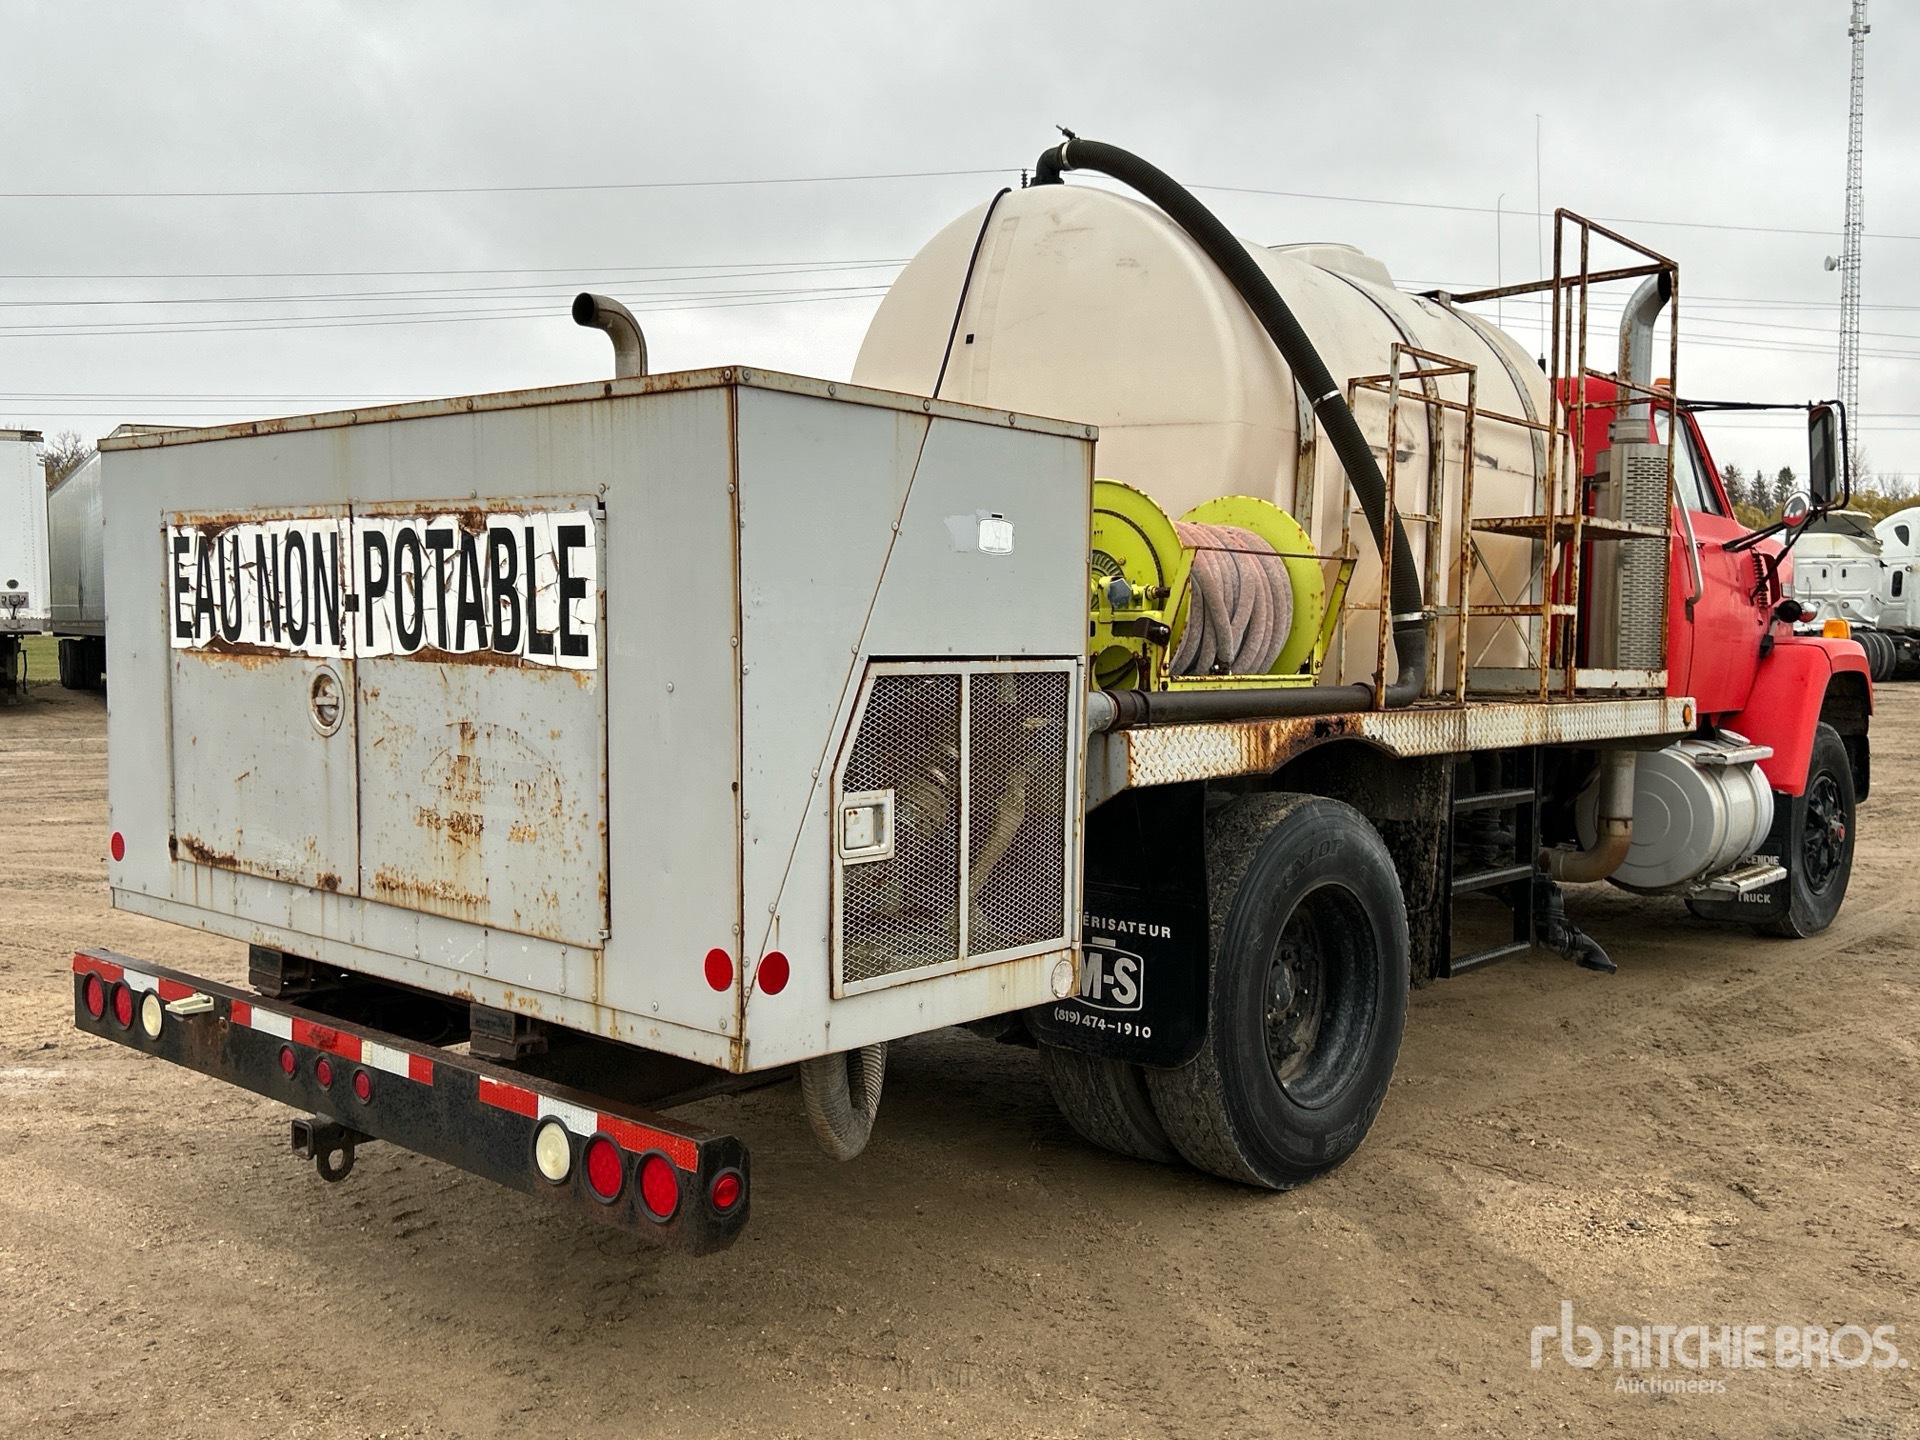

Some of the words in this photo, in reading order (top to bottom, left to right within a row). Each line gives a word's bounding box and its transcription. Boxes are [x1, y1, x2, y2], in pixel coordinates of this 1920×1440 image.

[173, 532, 243, 642] EAU
[255, 525, 589, 658] NON-POTABLE
[1743, 855, 1780, 866] CENDIE
[1054, 1007, 1080, 1025] (819)
[1082, 1014, 1151, 1038] 474-1910
